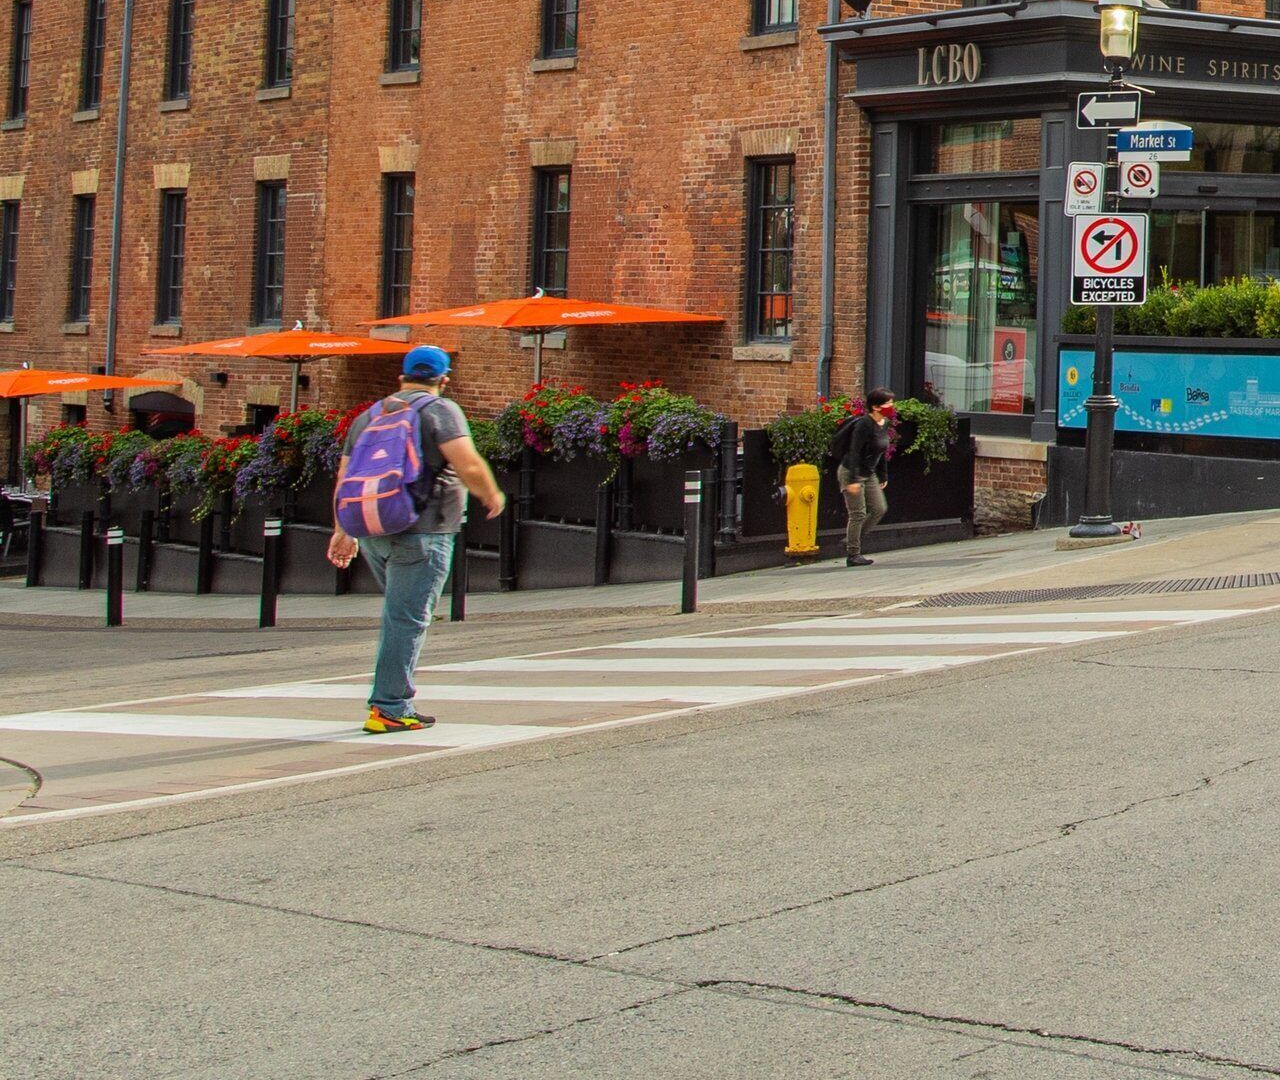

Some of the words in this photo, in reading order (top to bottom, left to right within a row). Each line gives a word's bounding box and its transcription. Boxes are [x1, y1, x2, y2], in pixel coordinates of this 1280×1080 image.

[917, 42, 983, 86] LCBO
[1131, 54, 1186, 74] WINE
[1130, 134, 1165, 148] Market
[1167, 138, 1177, 148] St
[1149, 152, 1158, 160] 26
[1083, 278, 1135, 289] BICYCLES
[1081, 291, 1136, 302] EXCEPTED
[1229, 406, 1253, 416] TASTES
[1254, 407, 1264, 416] OF
